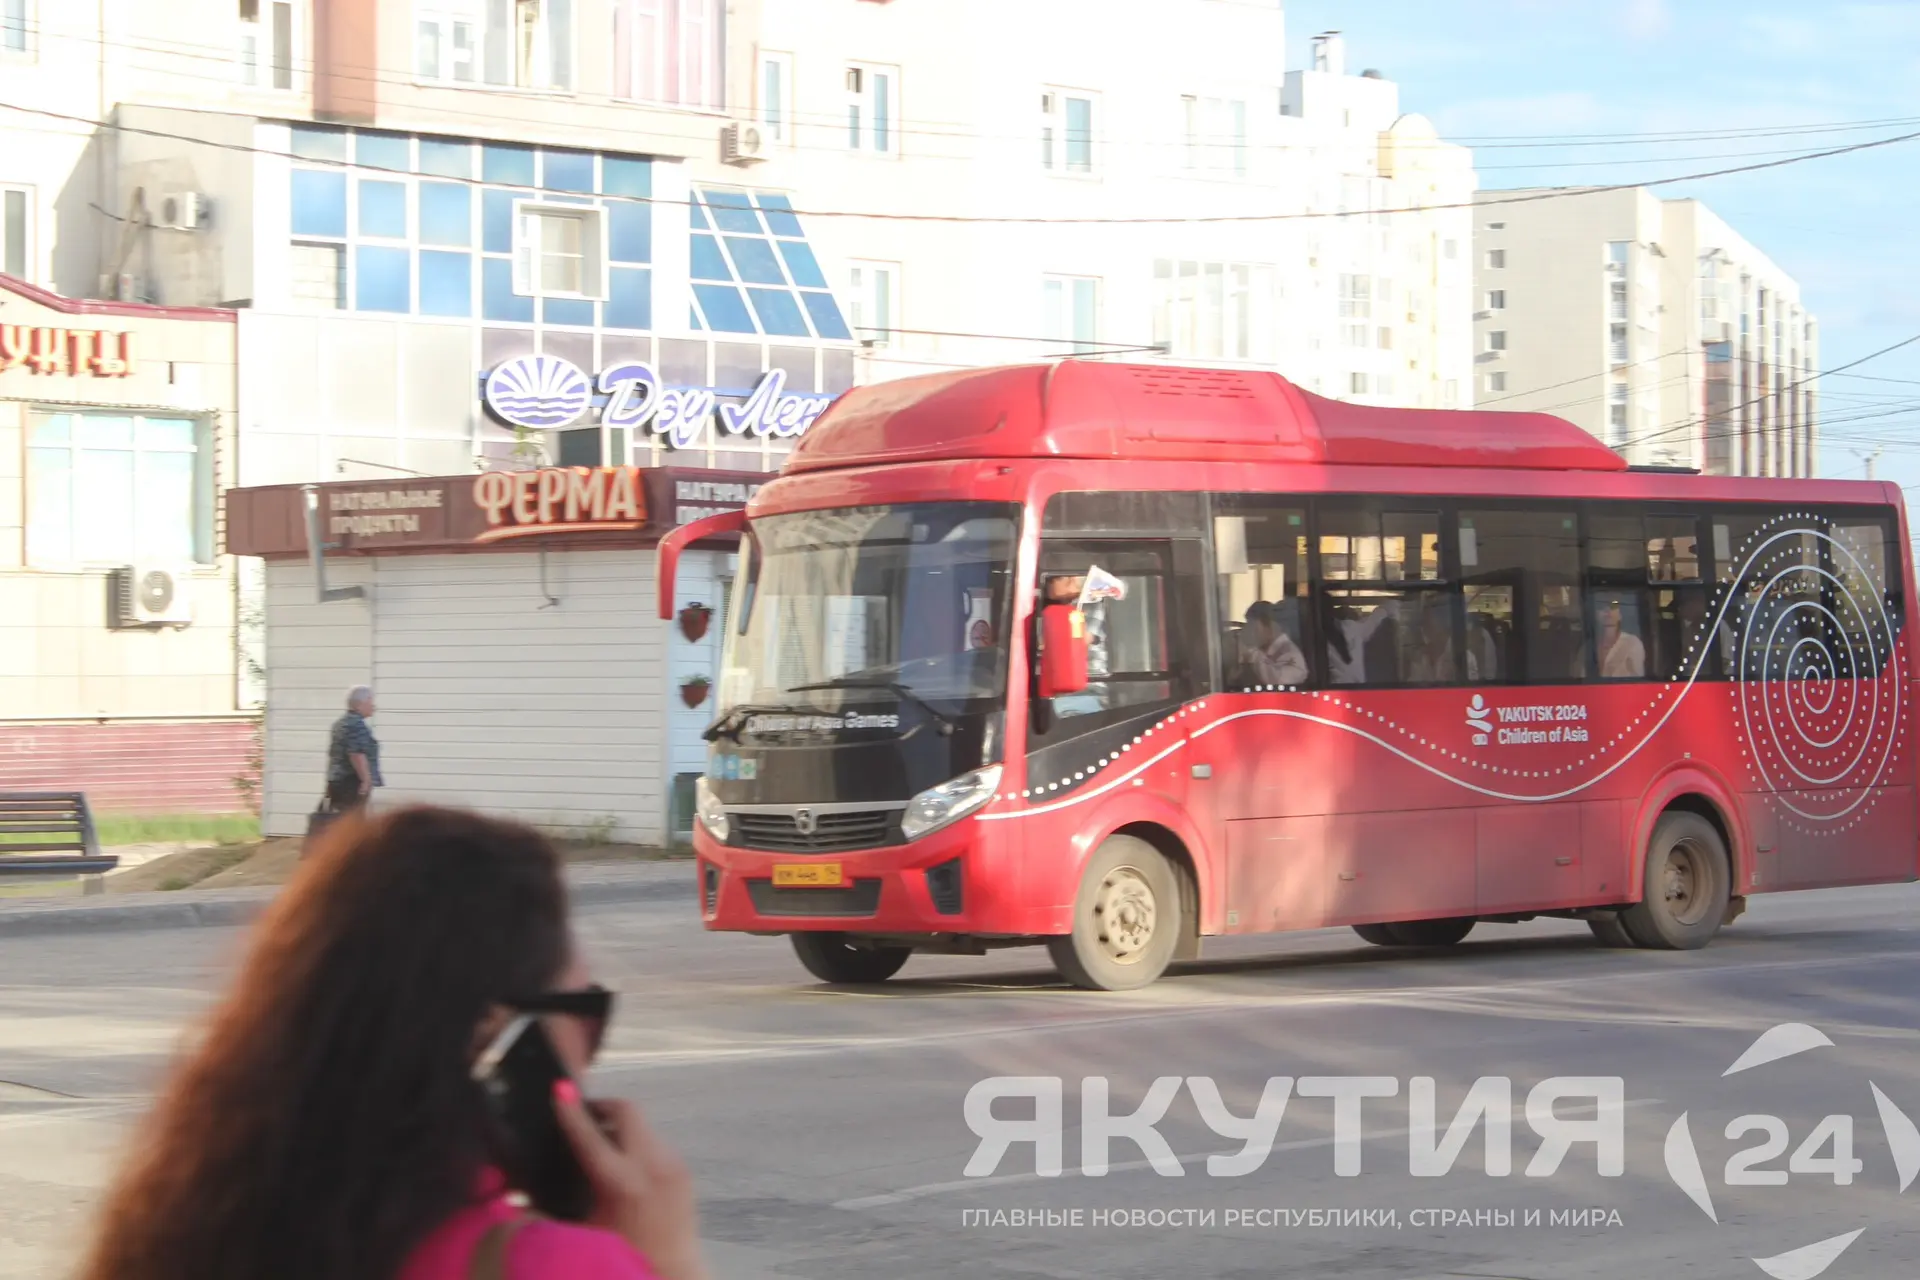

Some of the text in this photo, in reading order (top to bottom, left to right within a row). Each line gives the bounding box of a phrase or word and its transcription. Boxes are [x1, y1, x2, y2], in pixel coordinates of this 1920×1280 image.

[472, 466, 642, 525] ФЕРМА
[1496, 704, 1587, 722] YAKUTSK 2024
[1497, 726, 1589, 745] Children of Asia
